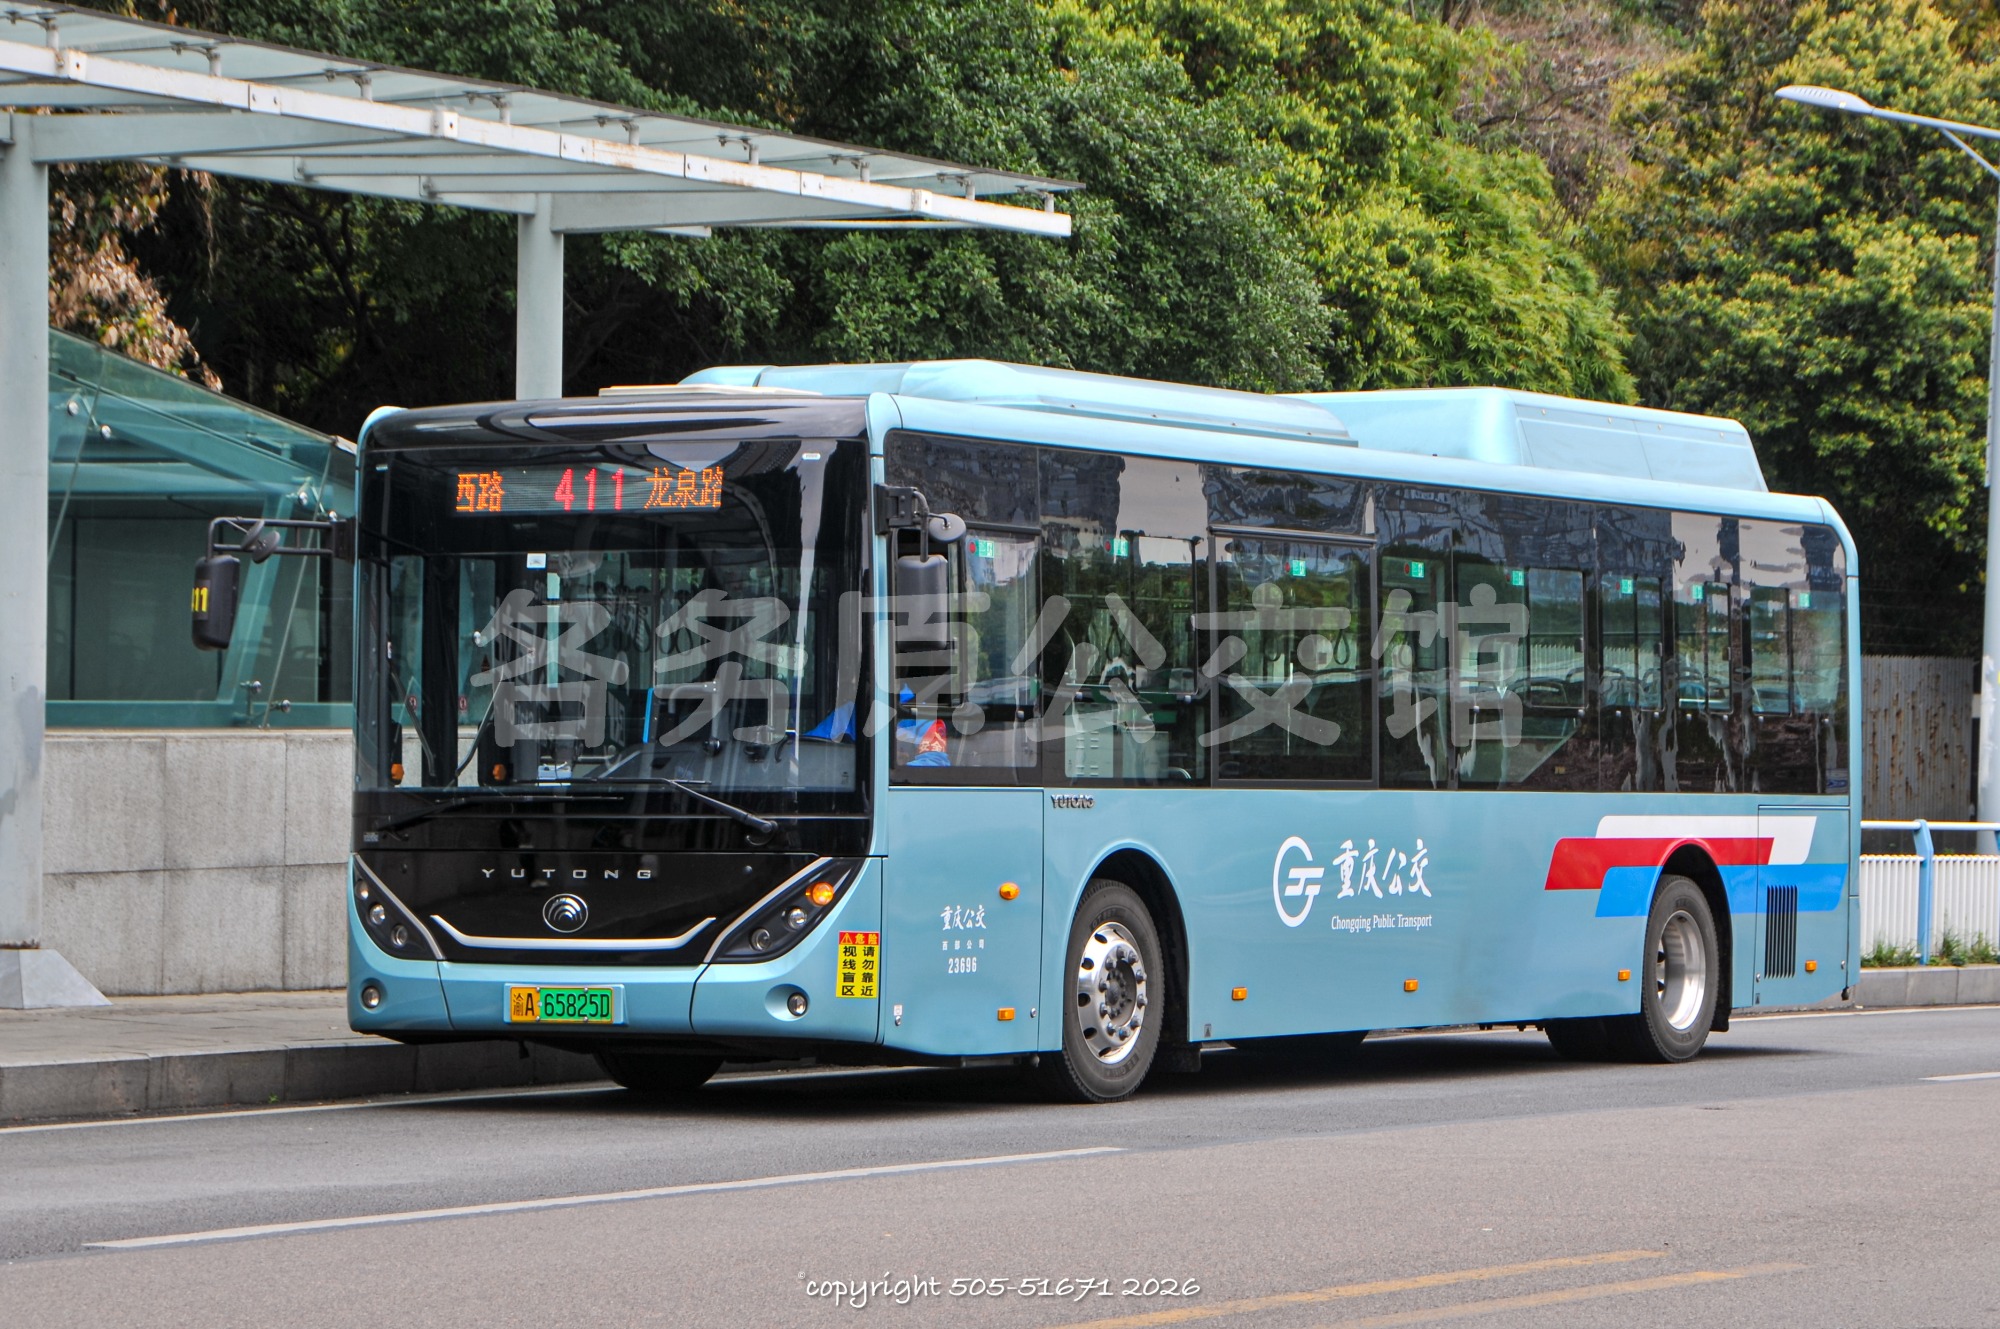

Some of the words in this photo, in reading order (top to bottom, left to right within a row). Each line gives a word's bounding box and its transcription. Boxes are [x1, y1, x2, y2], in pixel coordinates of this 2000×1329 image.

[554, 468, 625, 511] 411
[644, 466, 723, 510] 龙泉路
[191, 586, 209, 612] 11
[481, 868, 652, 879] YUTONG
[1332, 838, 1432, 900] 重庆公交
[940, 904, 987, 931] 重庆公交
[1331, 915, 1372, 934] Chongqing
[1372, 914, 1396, 929] Public
[1396, 913, 1433, 931] Transport
[855, 933, 878, 945] 危险
[841, 946, 857, 997] 视线盲区
[860, 946, 876, 997] 请勿靠近
[948, 956, 977, 974] 23696
